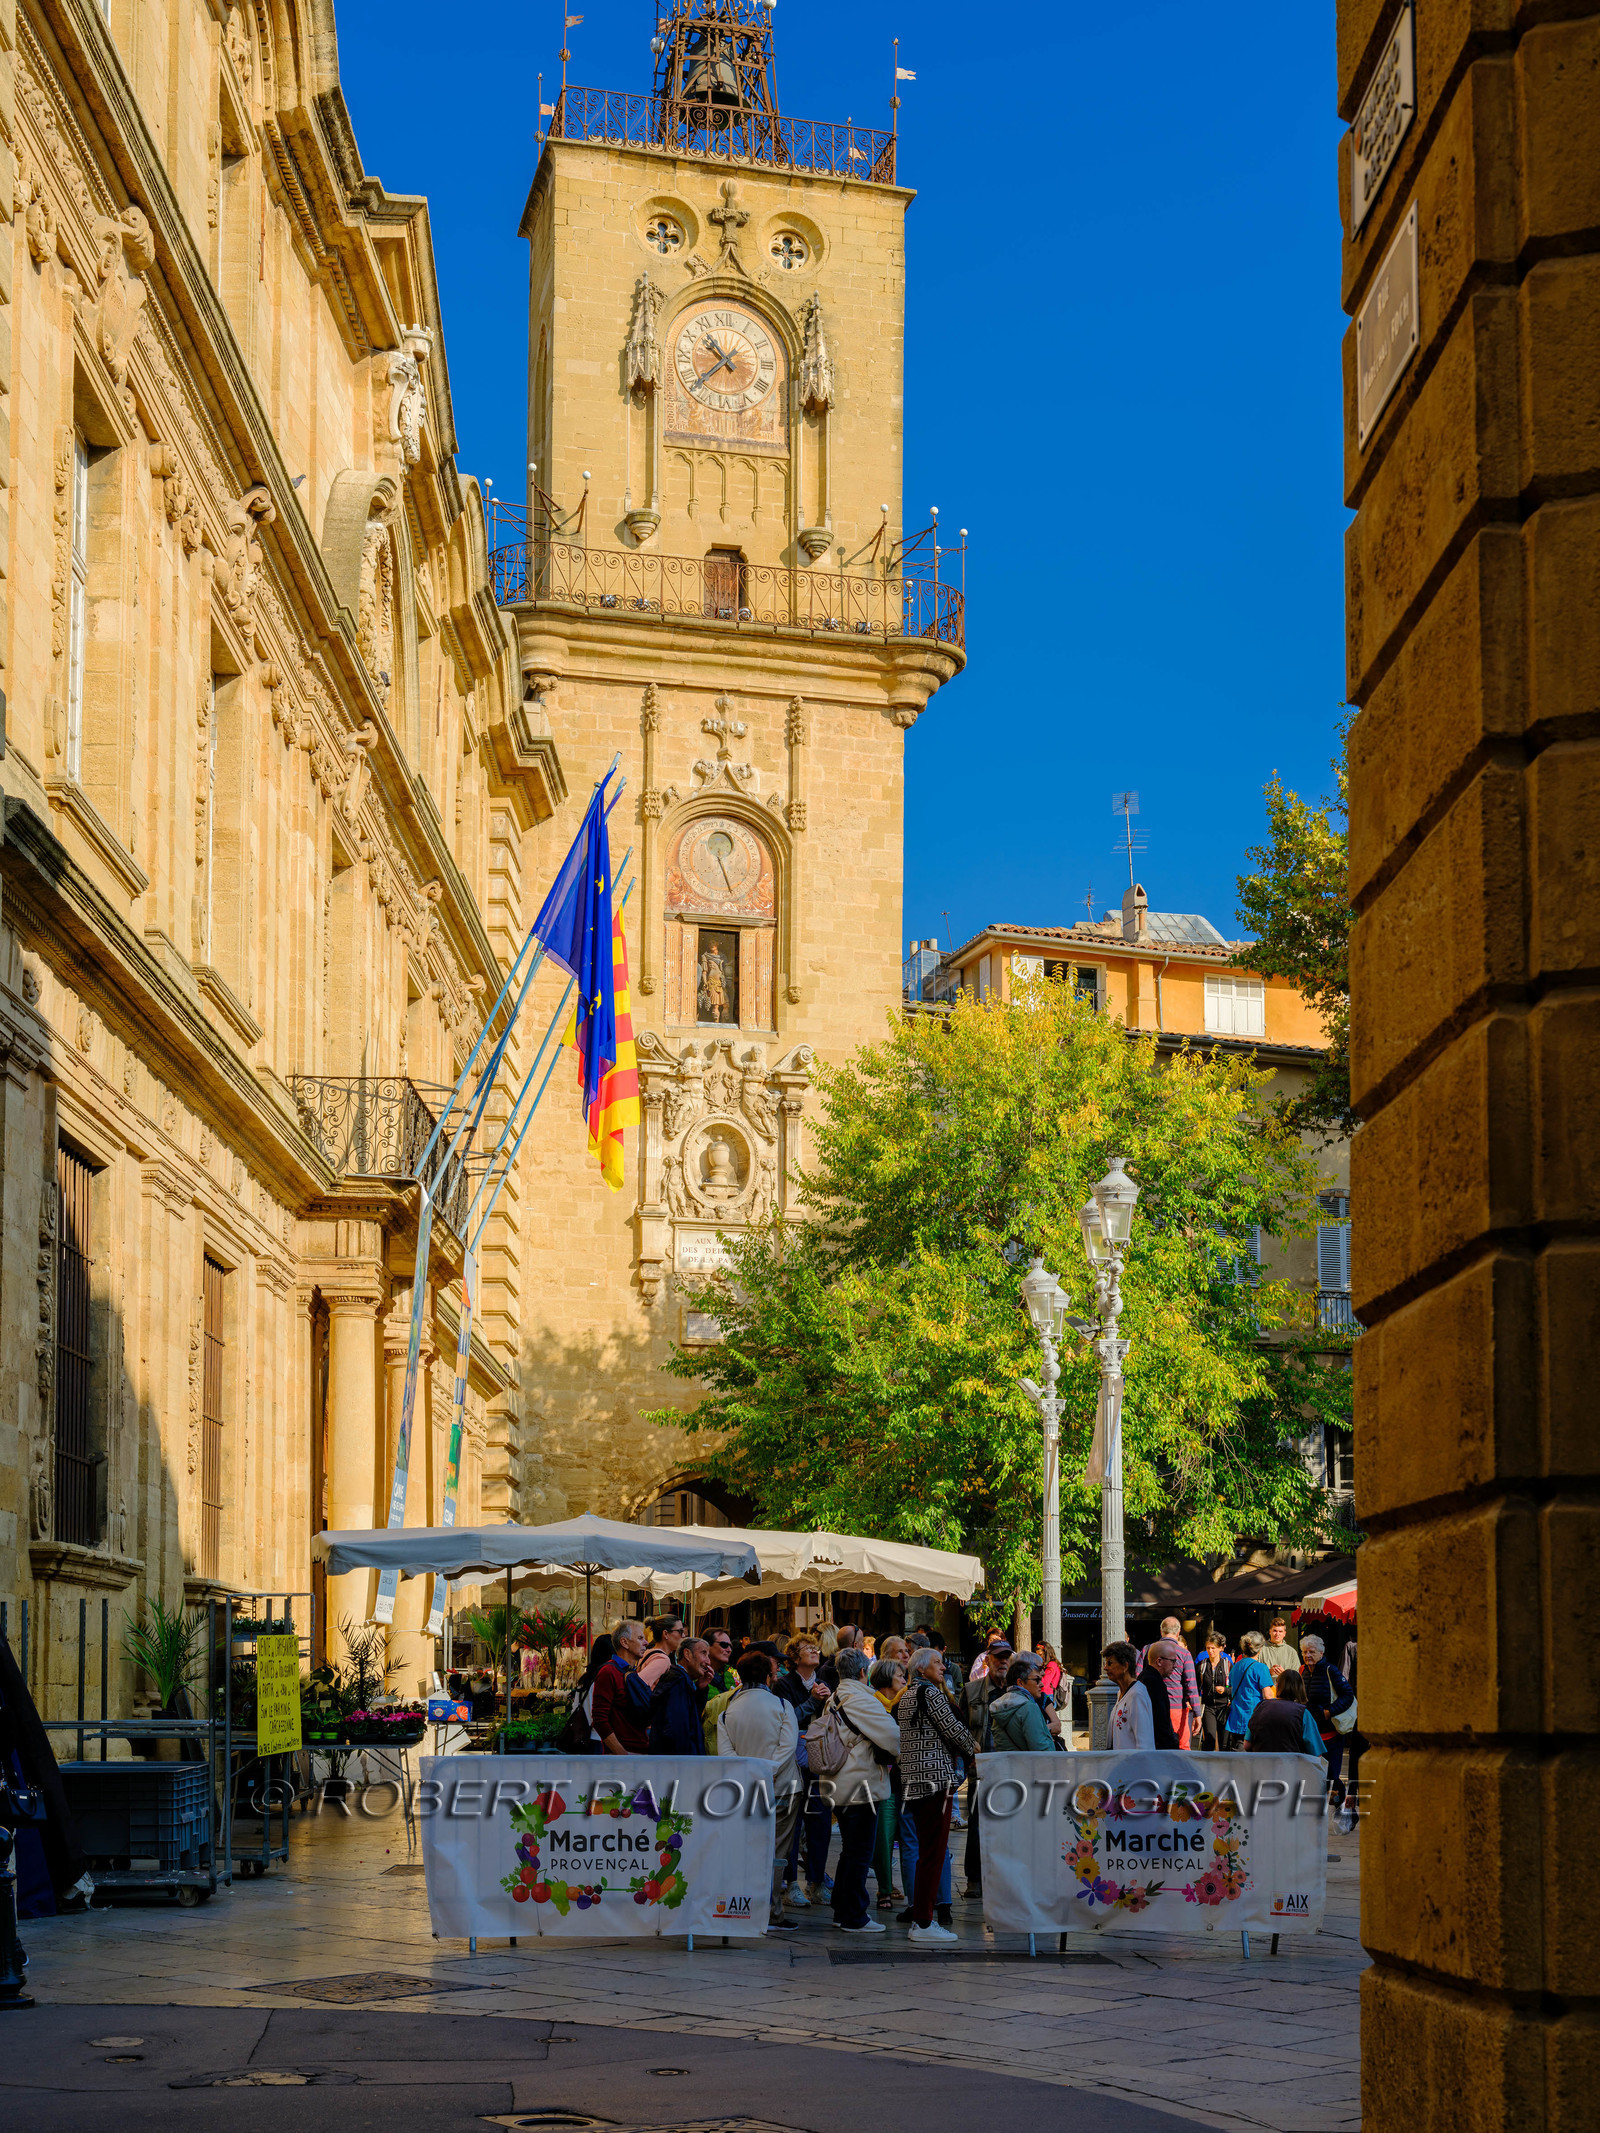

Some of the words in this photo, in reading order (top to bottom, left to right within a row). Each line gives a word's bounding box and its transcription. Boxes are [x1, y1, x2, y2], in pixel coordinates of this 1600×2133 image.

[1377, 277, 1390, 317] RUE
[695, 316, 712, 332] XI
[714, 313, 733, 327] XII
[1391, 292, 1409, 342] FOCH
[742, 321, 751, 334] I
[683, 329, 697, 344] X
[755, 339, 768, 349] II
[1061, 1607, 1089, 1618] Brasserie
[1090, 1607, 1098, 1618] de
[274, 1702, 291, 1717] PARKING
[550, 1828, 650, 1853] Marché
[1106, 1828, 1205, 1852] Marché
[550, 1858, 649, 1872] PROVENÇAL
[1107, 1858, 1204, 1871] PROVENÇAL
[728, 1896, 752, 1911] AIX
[1286, 1894, 1308, 1908] AIX
